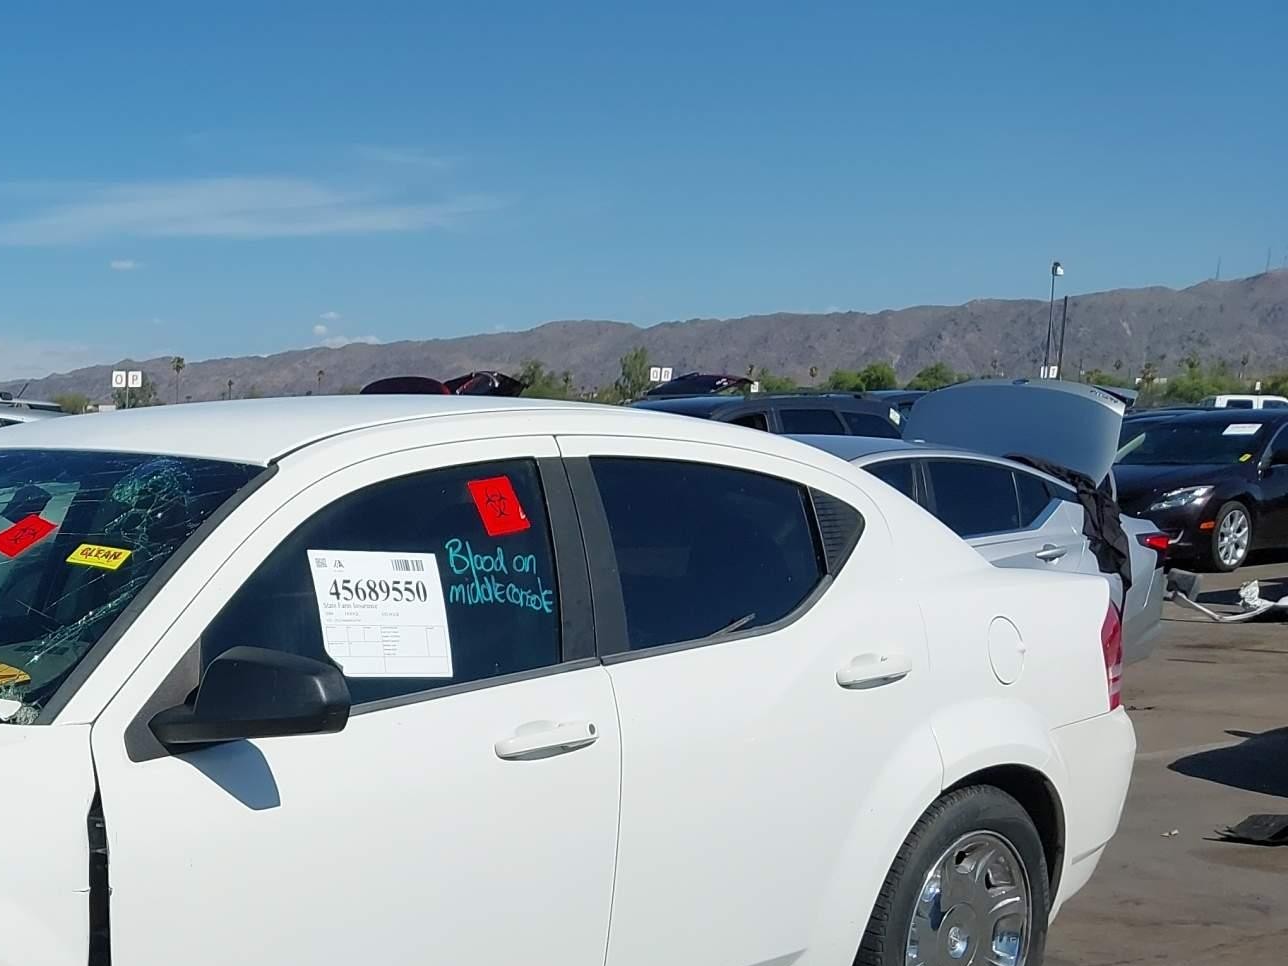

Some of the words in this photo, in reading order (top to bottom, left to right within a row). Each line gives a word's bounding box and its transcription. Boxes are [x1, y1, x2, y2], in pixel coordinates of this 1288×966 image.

[131, 374, 138, 385] P
[445, 538, 508, 576] Blood
[512, 554, 537, 575] on
[329, 578, 428, 602] 45689550
